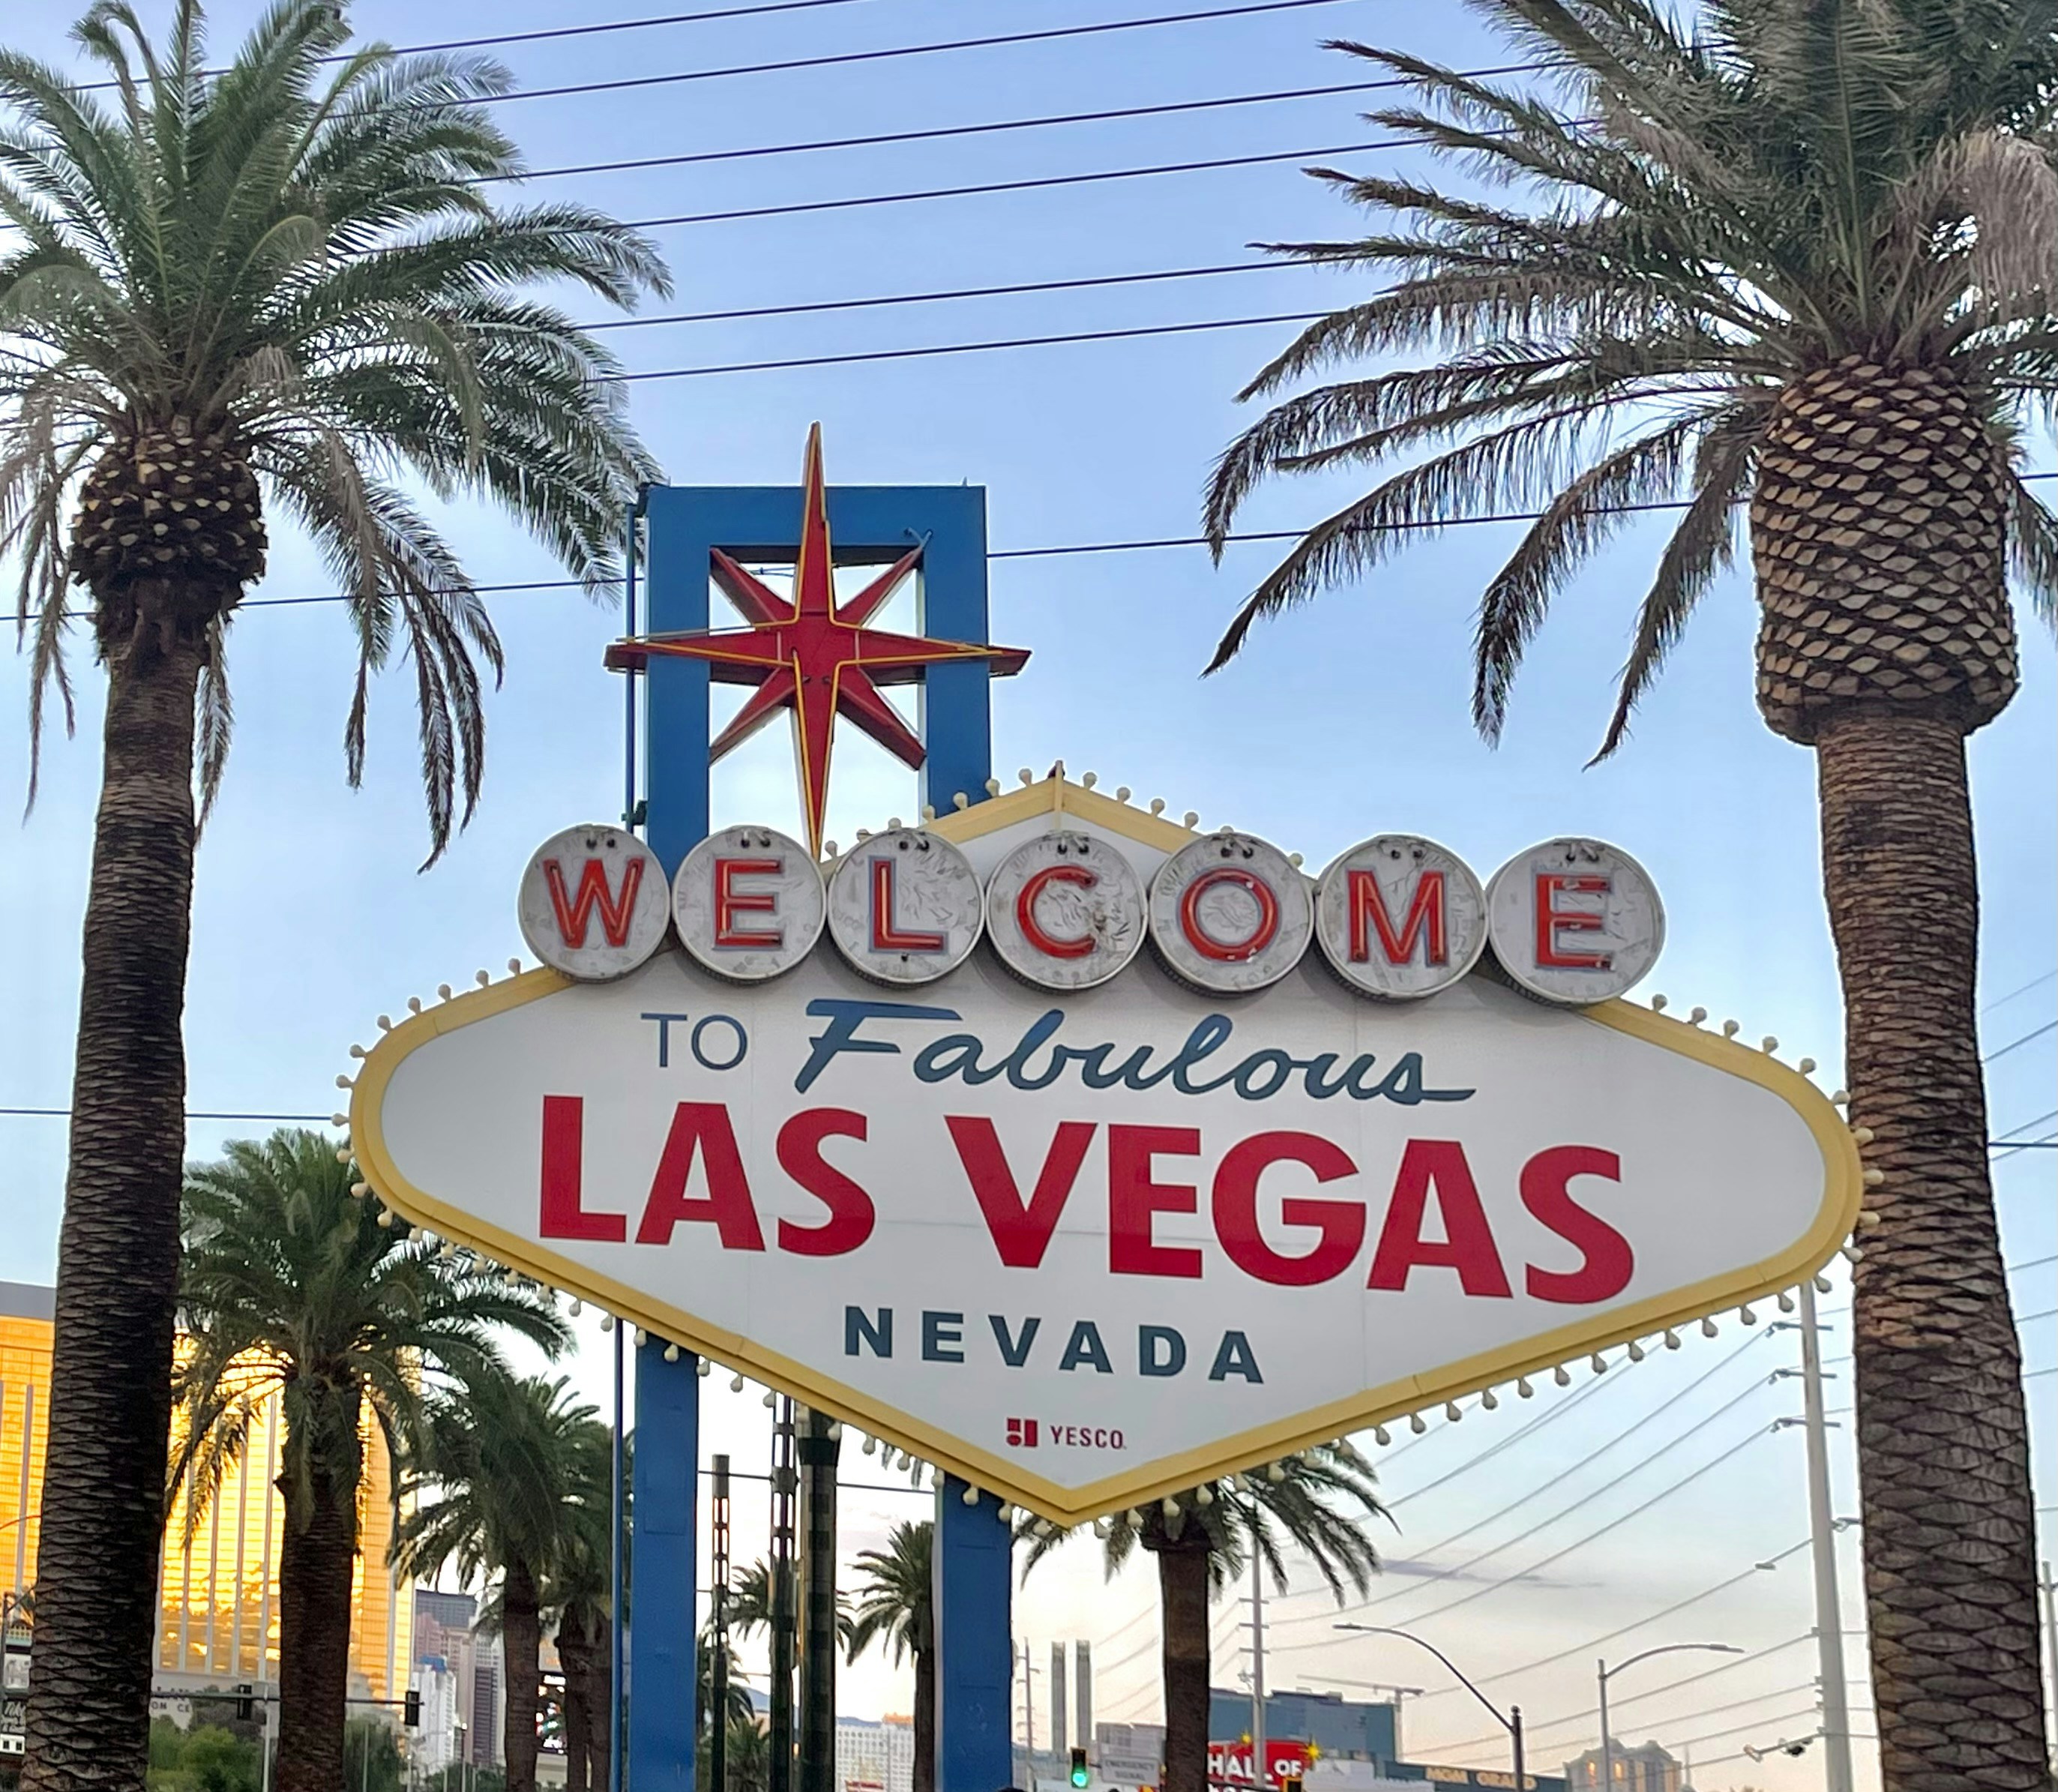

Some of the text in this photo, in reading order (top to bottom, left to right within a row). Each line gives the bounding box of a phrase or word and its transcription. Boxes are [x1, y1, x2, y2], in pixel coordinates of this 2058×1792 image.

[543, 857, 1615, 971] WELCOME
[641, 999, 1477, 1106] TO Fabulous
[539, 1095, 1634, 1305] LAS VEGAS
[844, 1305, 1265, 1386] NEVADA
[1050, 1424, 1125, 1450] YESCO
[1207, 1752, 1302, 1782] HAL OF
